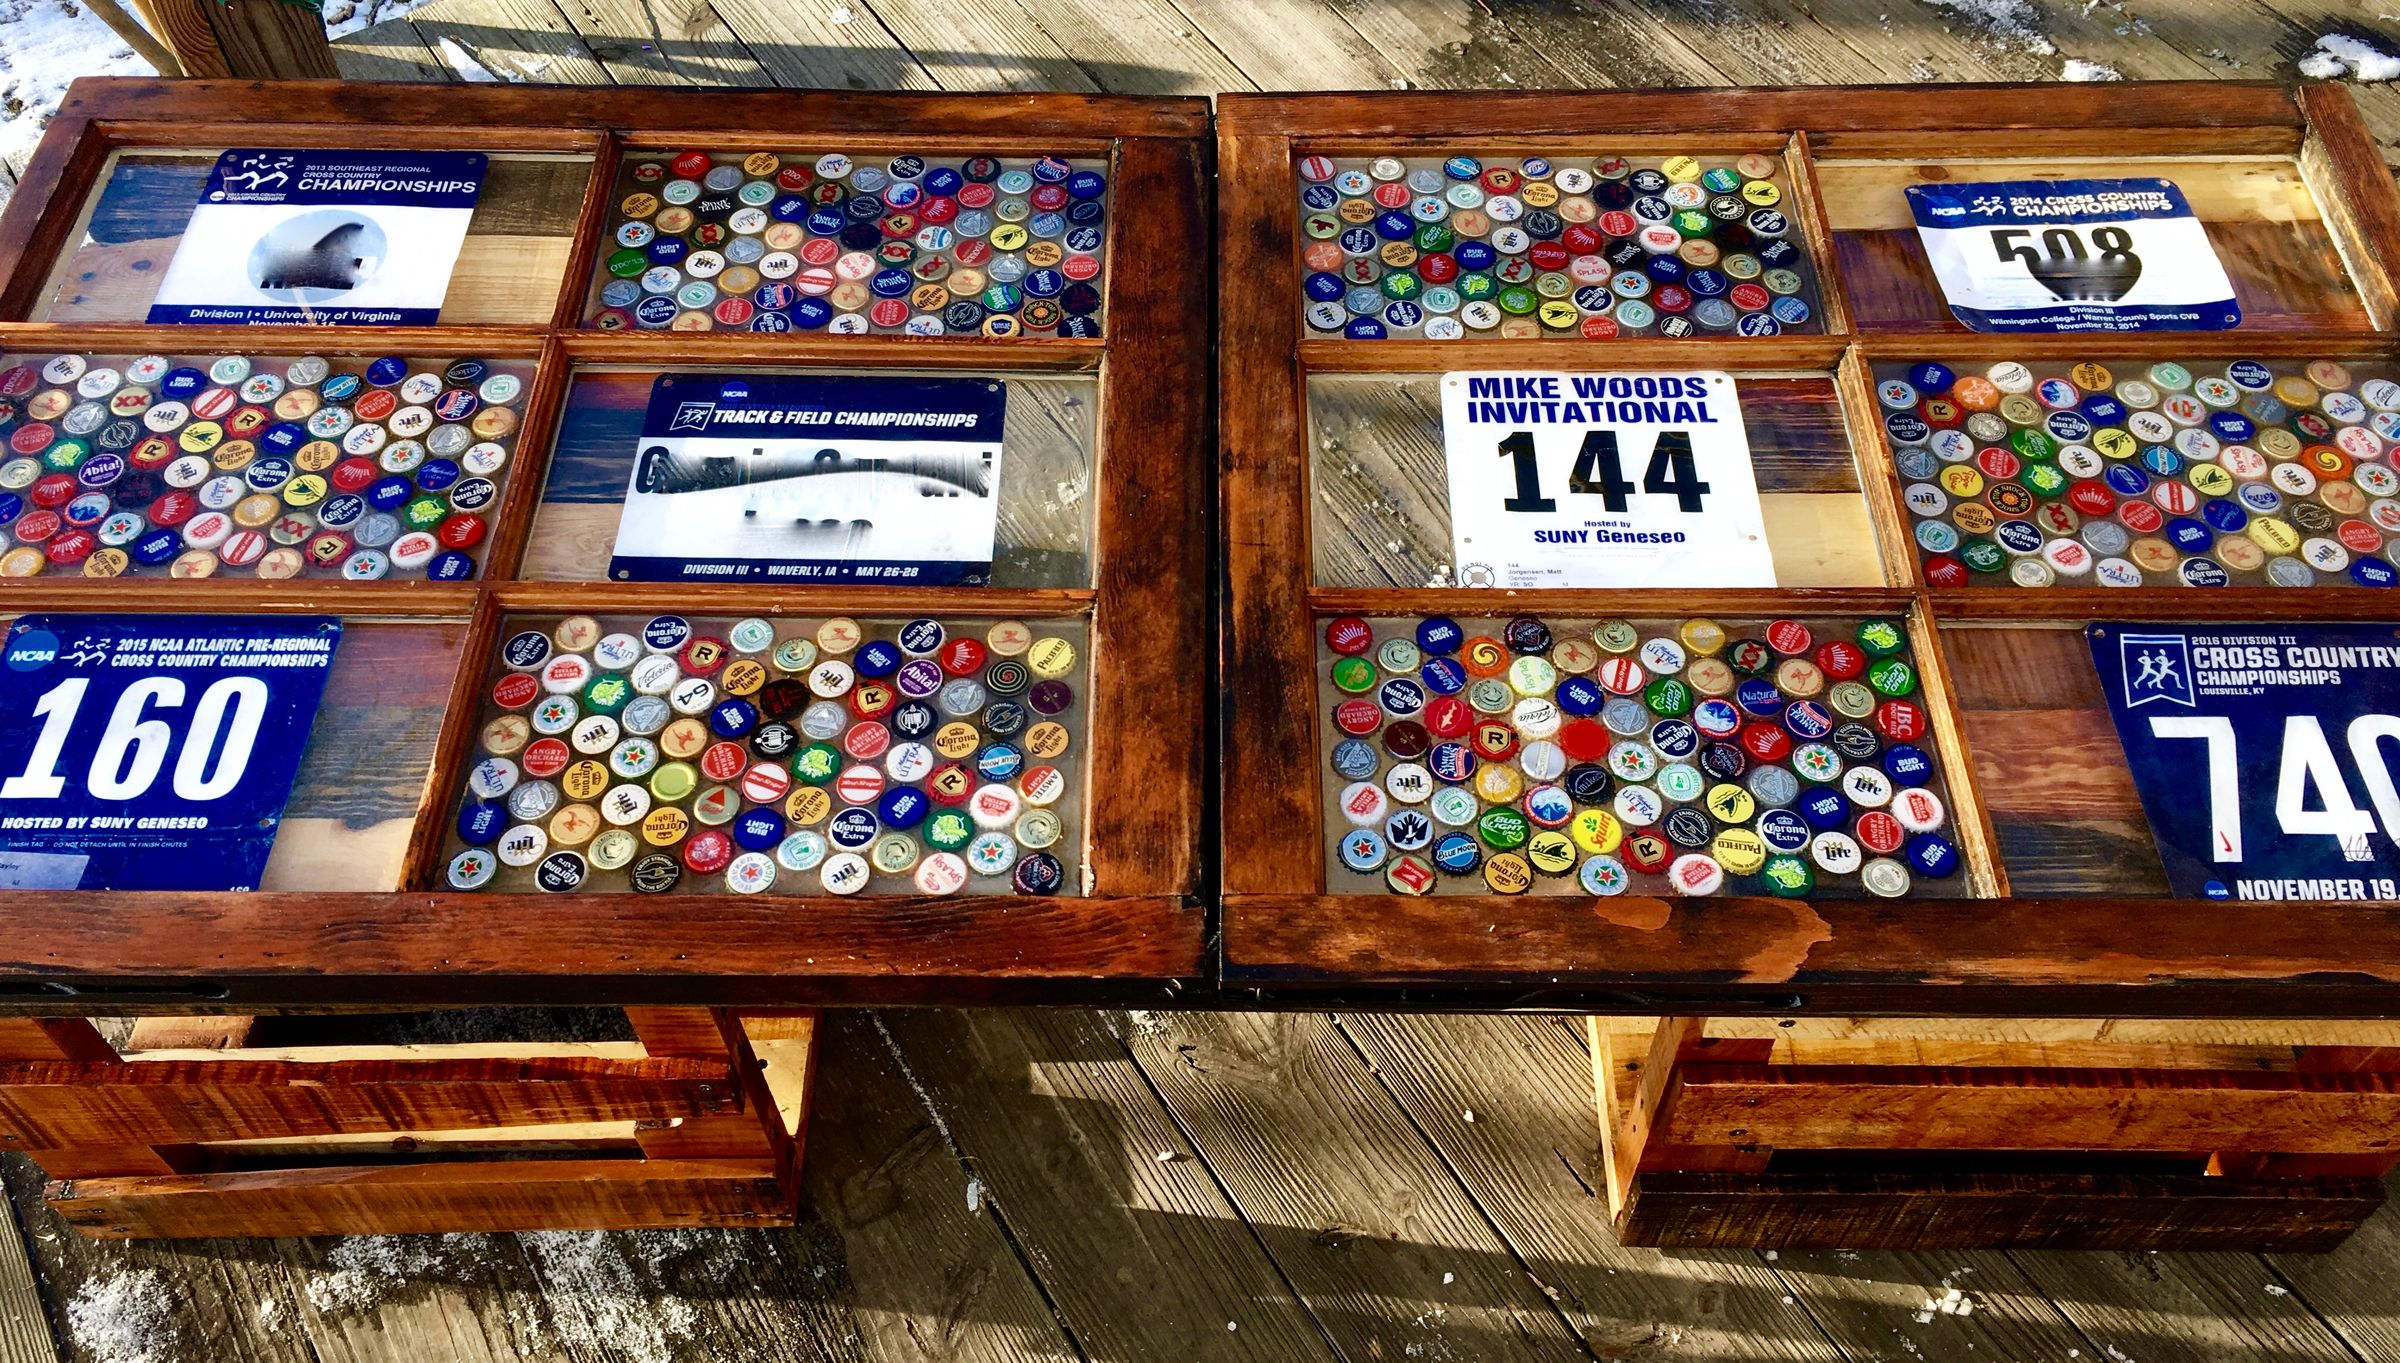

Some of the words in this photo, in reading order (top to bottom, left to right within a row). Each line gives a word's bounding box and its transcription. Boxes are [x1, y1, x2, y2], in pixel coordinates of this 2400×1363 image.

[298, 179, 476, 193] CHAMPIONSHIPS
[1524, 188, 1555, 198] Corona
[2010, 197, 2044, 206] 2014
[2046, 195, 2094, 205] CROSS
[2098, 192, 2166, 201] COUNTRY
[1932, 207, 1965, 215] NCAA
[2013, 200, 2172, 216] CHAMPIONSHIPS
[190, 310, 243, 319] Division
[264, 311, 330, 320] University
[351, 312, 401, 322] Virginia
[640, 305, 675, 315] Corona
[2041, 315, 2075, 323] College
[1468, 377, 1561, 399] MIKE
[1571, 377, 1708, 399] WOODS
[114, 395, 147, 408] XX
[1468, 401, 1718, 423] INVITATIONAL
[713, 410, 770, 423] TRACK
[769, 411, 783, 424] &
[785, 412, 832, 424] FIELD
[835, 412, 978, 427] CHAMPIONSHIPS
[214, 448, 253, 463] Corona
[83, 460, 120, 477] Abita!
[250, 466, 287, 478] Corona
[1498, 430, 1711, 512] 144
[1534, 530, 1588, 543] SUNY
[1596, 530, 1686, 543] Geneseo
[2001, 527, 2039, 543] Corona
[2179, 532, 2204, 541] LIGHT
[2181, 528, 2197, 536] BUD
[2258, 518, 2290, 548] PACIFICO
[683, 565, 734, 575] DIVISION
[736, 566, 749, 575] III
[768, 566, 822, 576] WAVERLY,
[825, 567, 837, 576] IA
[856, 567, 882, 577] MAY
[883, 568, 919, 577] 26-28
[1428, 626, 1449, 635] BUD
[1429, 631, 1455, 642] LIGHT
[117, 639, 148, 651] 2015
[150, 639, 183, 651] NCAA
[187, 639, 244, 651] ATLANTIC
[246, 639, 330, 651] PRE-REGIONAL
[2192, 637, 2220, 645] 2016
[2223, 637, 2276, 645] DIVISION
[2279, 637, 2296, 645] III
[10, 651, 54, 661] NCAA
[111, 654, 154, 667] CROSS
[157, 654, 216, 667] COUNTRY
[220, 654, 328, 667] CHAMPIONSHIPS
[1038, 640, 1065, 670] PACIFICO
[2194, 648, 2280, 668] CROSS
[2289, 647, 2400, 668] COUNTRY
[555, 667, 578, 675] STELLA
[905, 666, 936, 689] Abita!
[2197, 671, 2341, 685] CHAMPIONSHIPS
[1742, 689, 1778, 701] Natural
[1898, 705, 1912, 738] IBC
[1, 676, 268, 800] 160
[936, 735, 976, 745] Corona
[950, 743, 970, 752] Light
[1896, 764, 1926, 772] LIGHT
[1854, 780, 1882, 795] Lite
[1, 818, 63, 829] HOSTED
[66, 818, 88, 829] BY
[89, 817, 134, 829] SUNY
[137, 818, 208, 829] GENESEO
[1491, 821, 1525, 831] LIGHT
[1495, 815, 1522, 825] BUD
[833, 821, 874, 834] Corona
[1591, 813, 1611, 849] Squirt
[1763, 823, 1806, 835] Corona
[842, 831, 865, 840] Extra
[1777, 834, 1799, 842] Extra
[1437, 848, 1457, 860] BLUE
[1457, 843, 1477, 855] MOON
[1825, 847, 1851, 861] Lite
[2237, 880, 2367, 900] NOVEMBER
